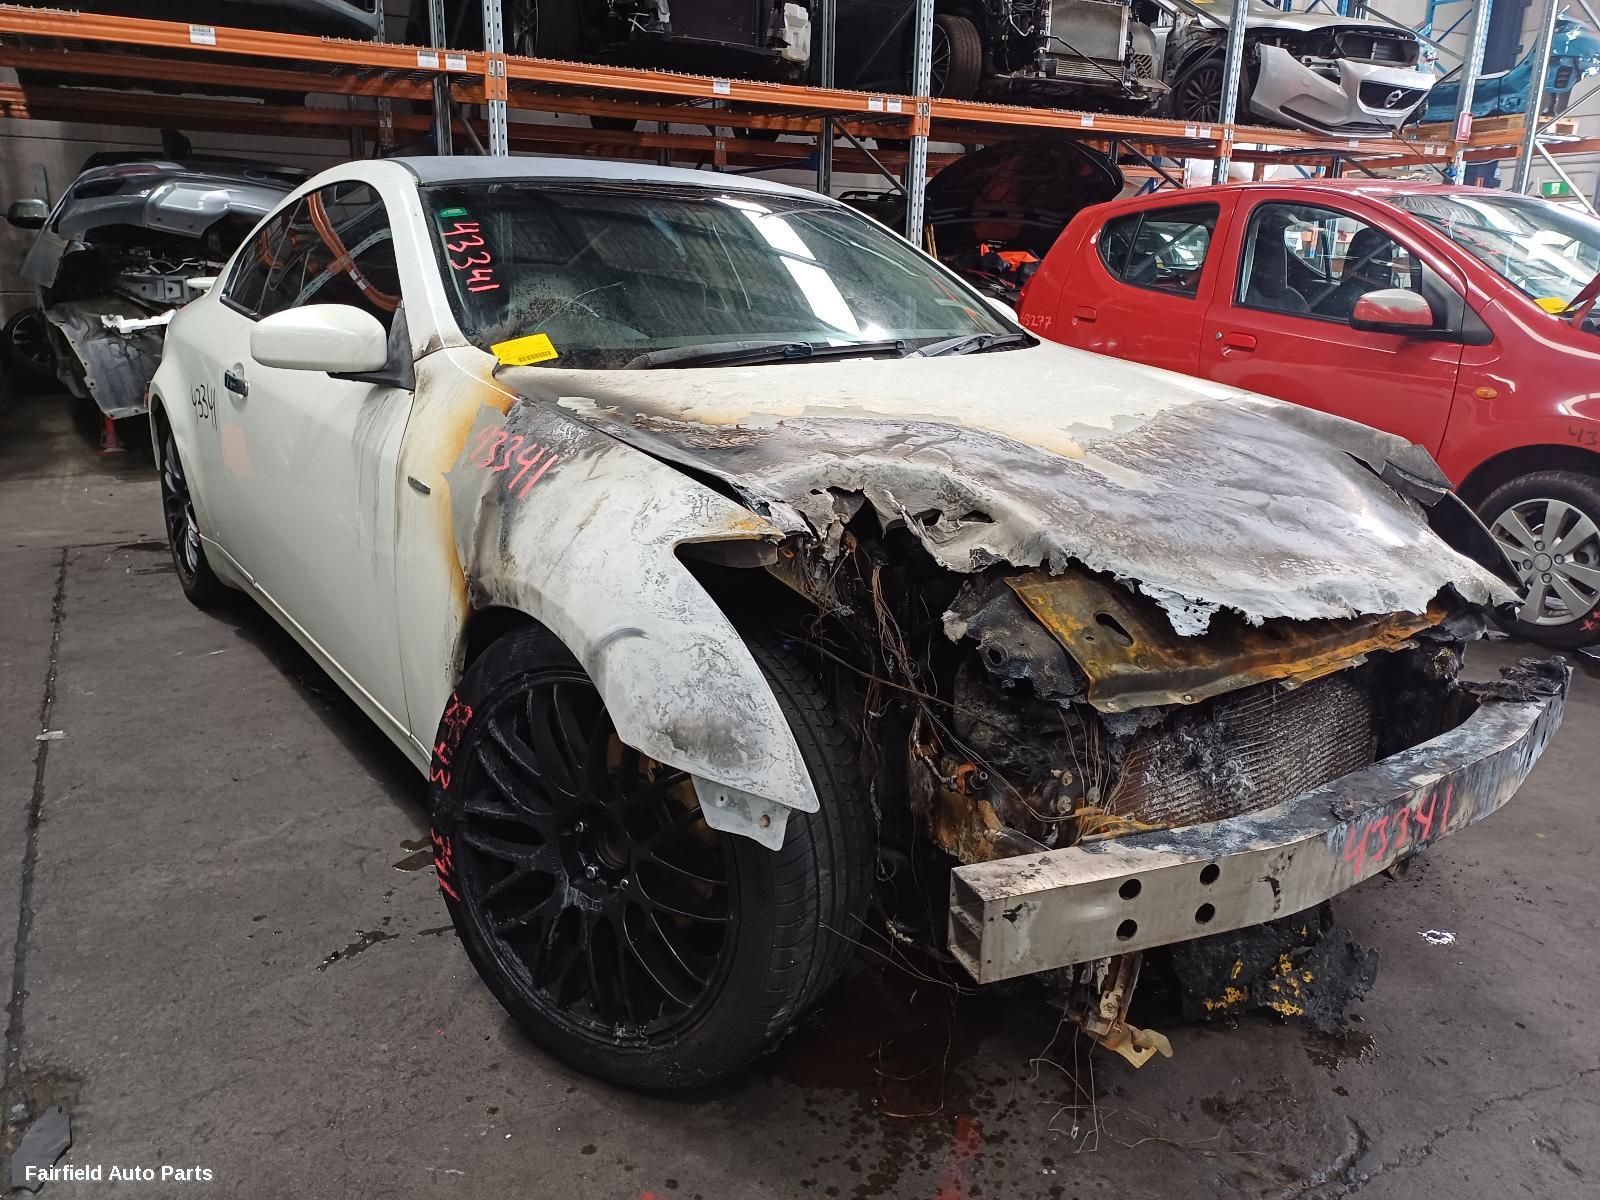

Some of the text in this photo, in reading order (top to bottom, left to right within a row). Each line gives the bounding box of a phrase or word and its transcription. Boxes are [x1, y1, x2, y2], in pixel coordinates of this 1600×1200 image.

[441, 221, 500, 293] 43341
[190, 383, 218, 431] 43341
[469, 424, 556, 499] 43341
